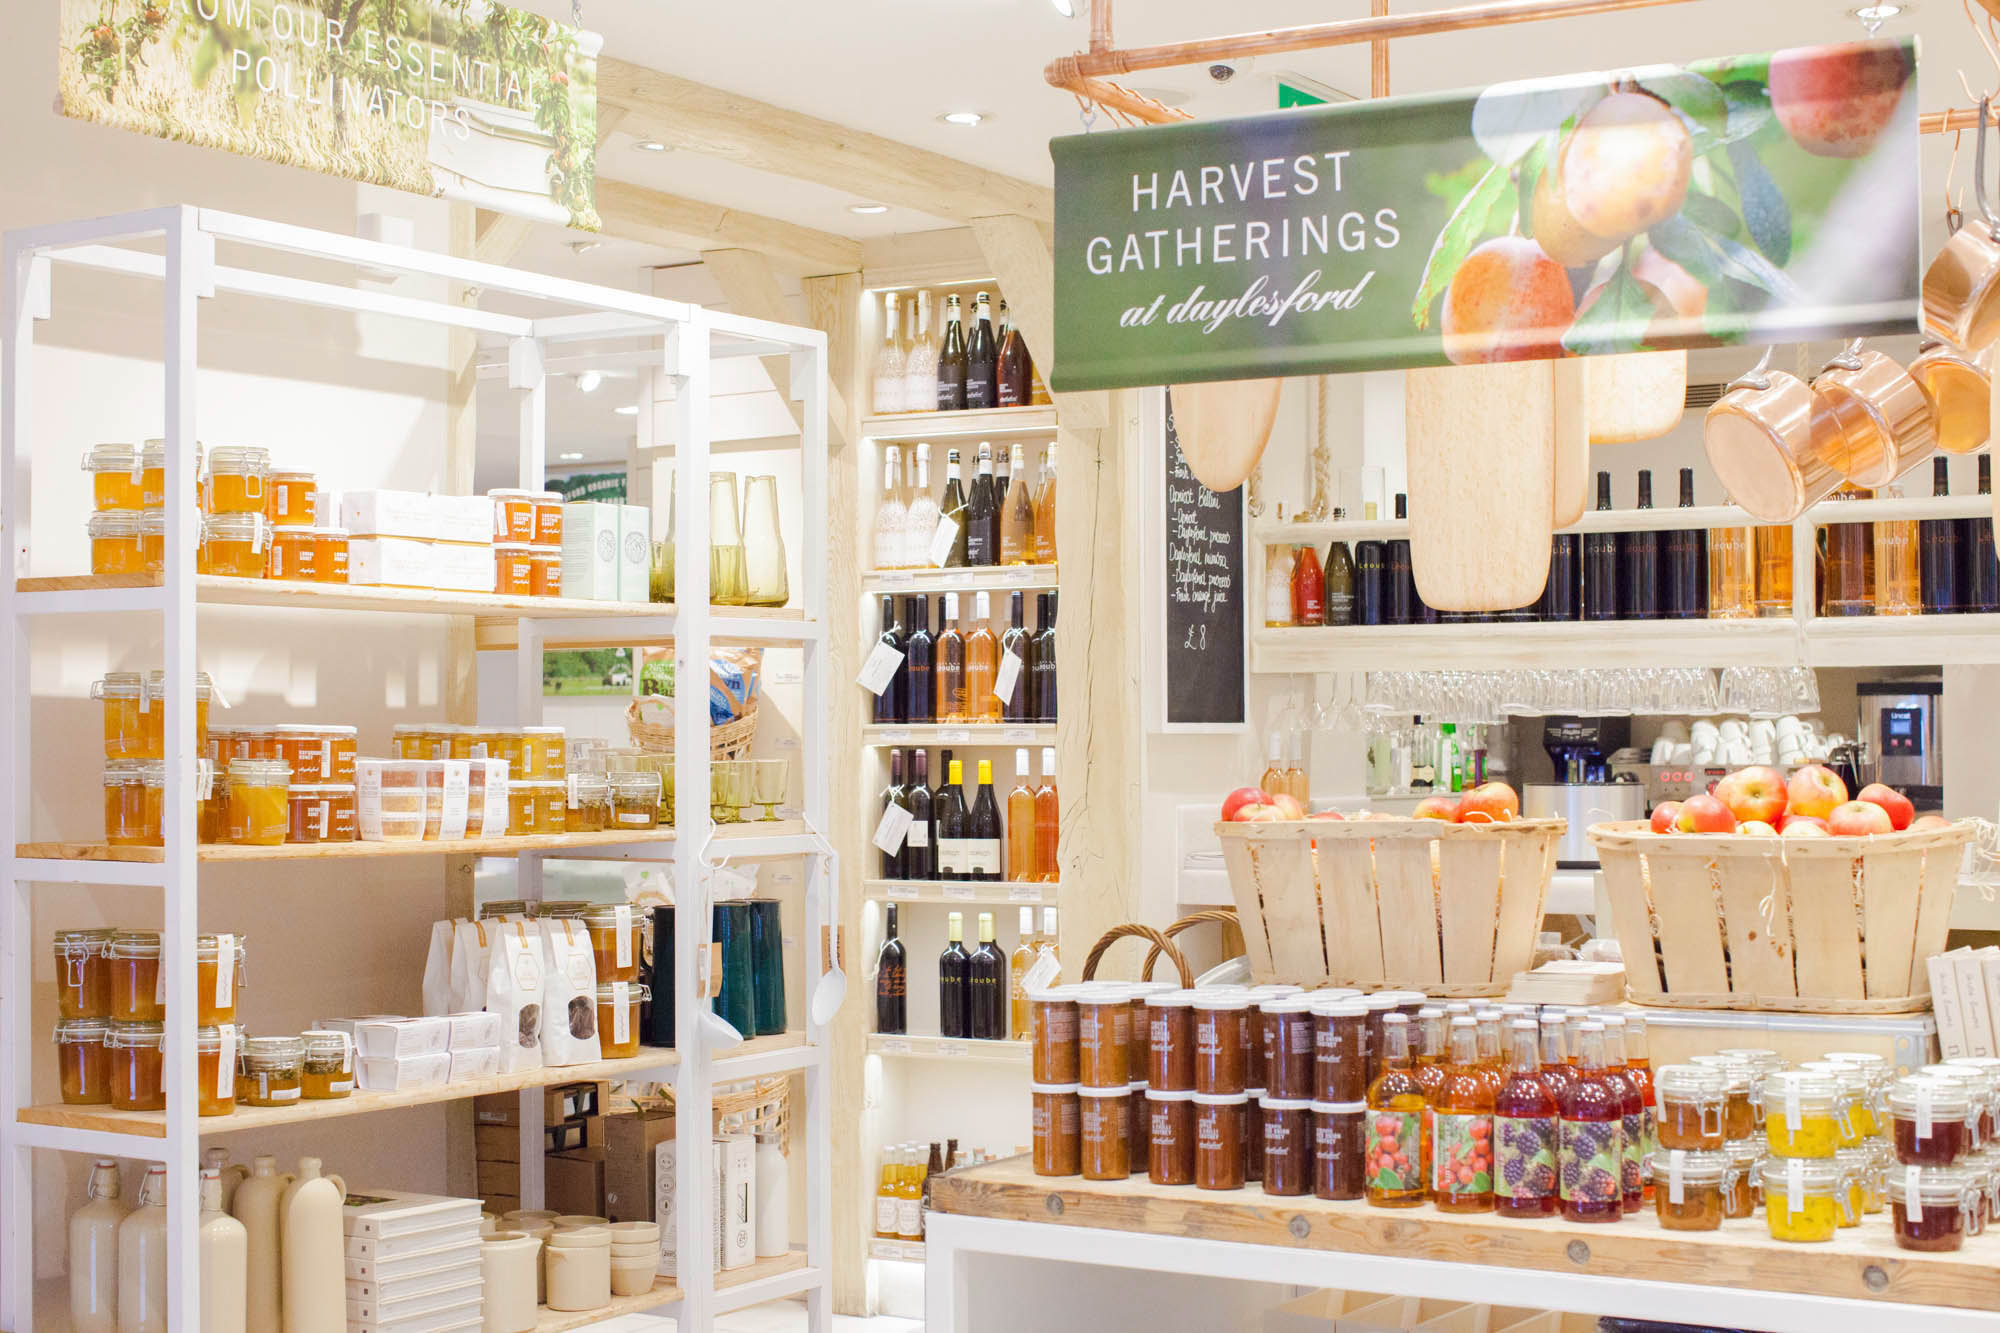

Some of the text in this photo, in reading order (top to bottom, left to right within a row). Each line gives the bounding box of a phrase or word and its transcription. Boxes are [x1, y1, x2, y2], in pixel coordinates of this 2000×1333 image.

[272, 4, 345, 56] OUR
[364, 29, 542, 110] ESSENTIAL
[232, 48, 471, 142] POLLINATORS
[1132, 151, 1351, 213] HARVEST
[1086, 208, 1401, 275] GATHERINGS
[1119, 269, 1376, 334] at daylesford
